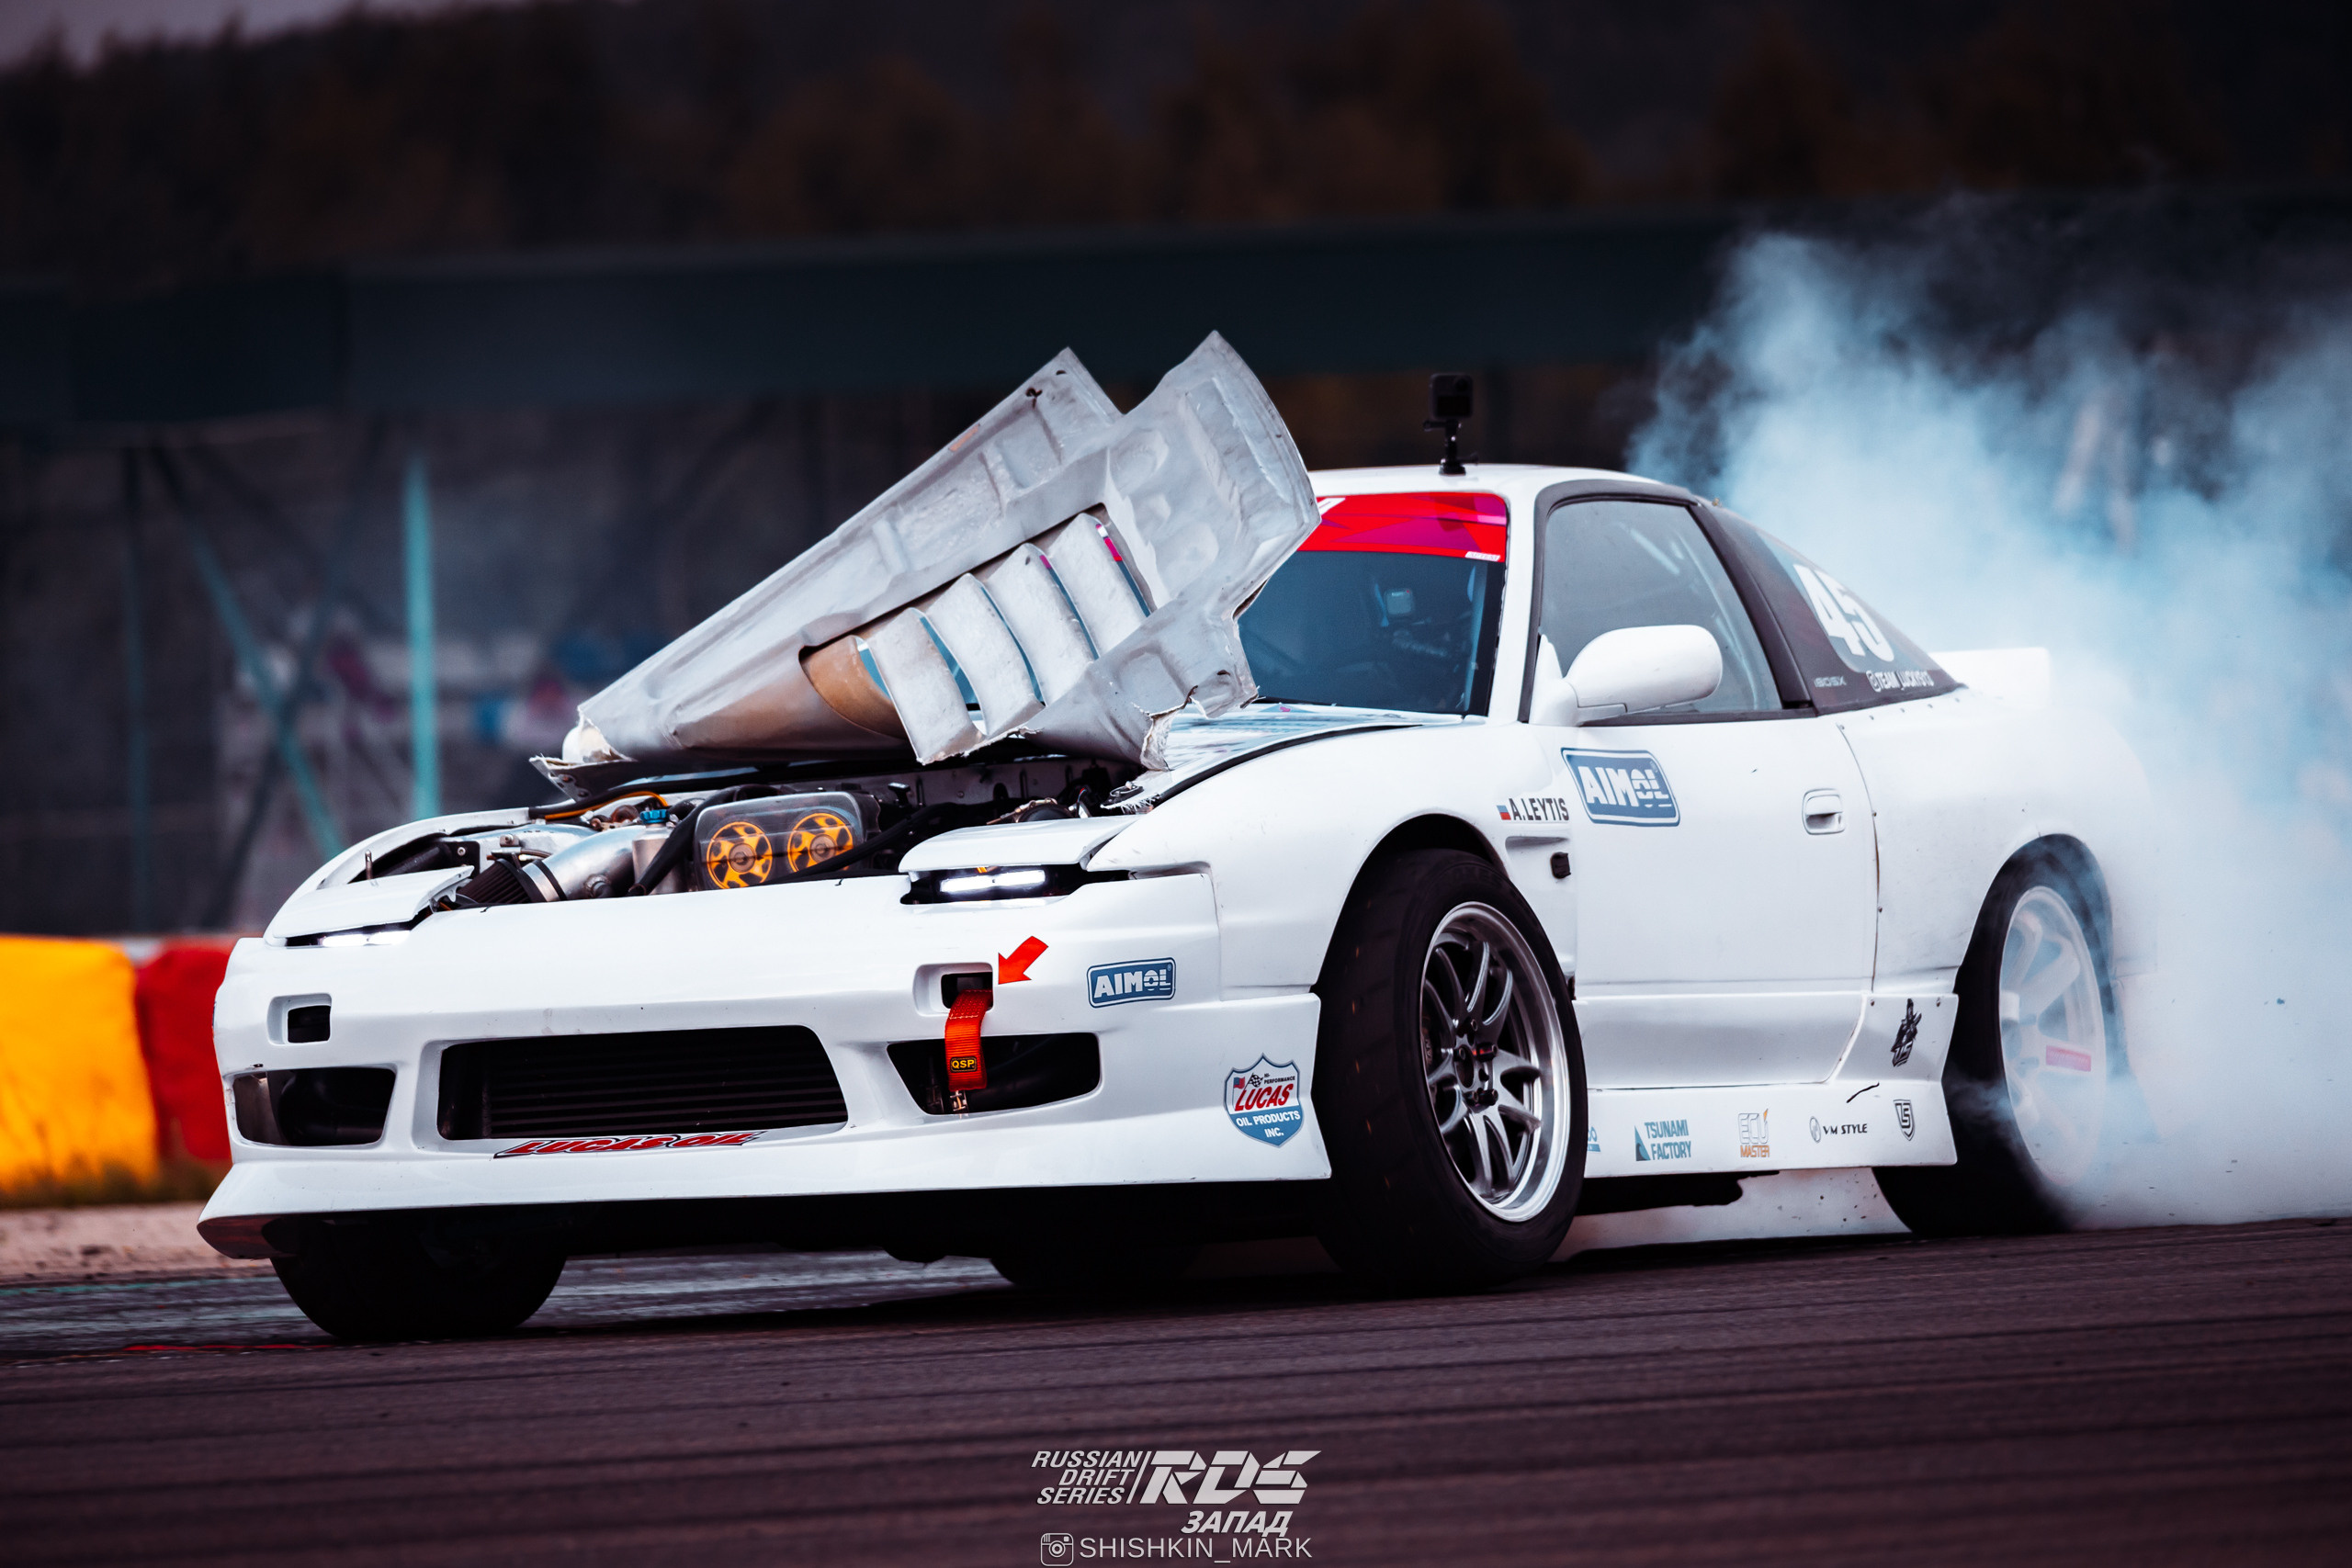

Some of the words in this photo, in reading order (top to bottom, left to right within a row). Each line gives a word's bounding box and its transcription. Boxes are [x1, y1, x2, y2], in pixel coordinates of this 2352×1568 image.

[1577, 765, 1672, 808] AIMOL
[1509, 797, 1570, 821] A.LEYTIS
[1093, 968, 1171, 998] AIMOL
[951, 1059, 975, 1069] QSP
[1234, 1083, 1295, 1111] LUCAS
[1236, 1117, 1253, 1127] OIL
[1252, 1111, 1301, 1125] PRODUCTS
[1644, 1119, 1690, 1139] TSUNAMI
[1738, 1110, 1769, 1144] ECU
[1823, 1125, 1838, 1135] VM
[1841, 1123, 1868, 1134] STYLE
[1264, 1127, 1284, 1138] INC.
[499, 1135, 678, 1154] LUCAS
[672, 1133, 760, 1147] OIL
[1651, 1141, 1691, 1160] FACTORY
[1740, 1145, 1770, 1157] MASTER
